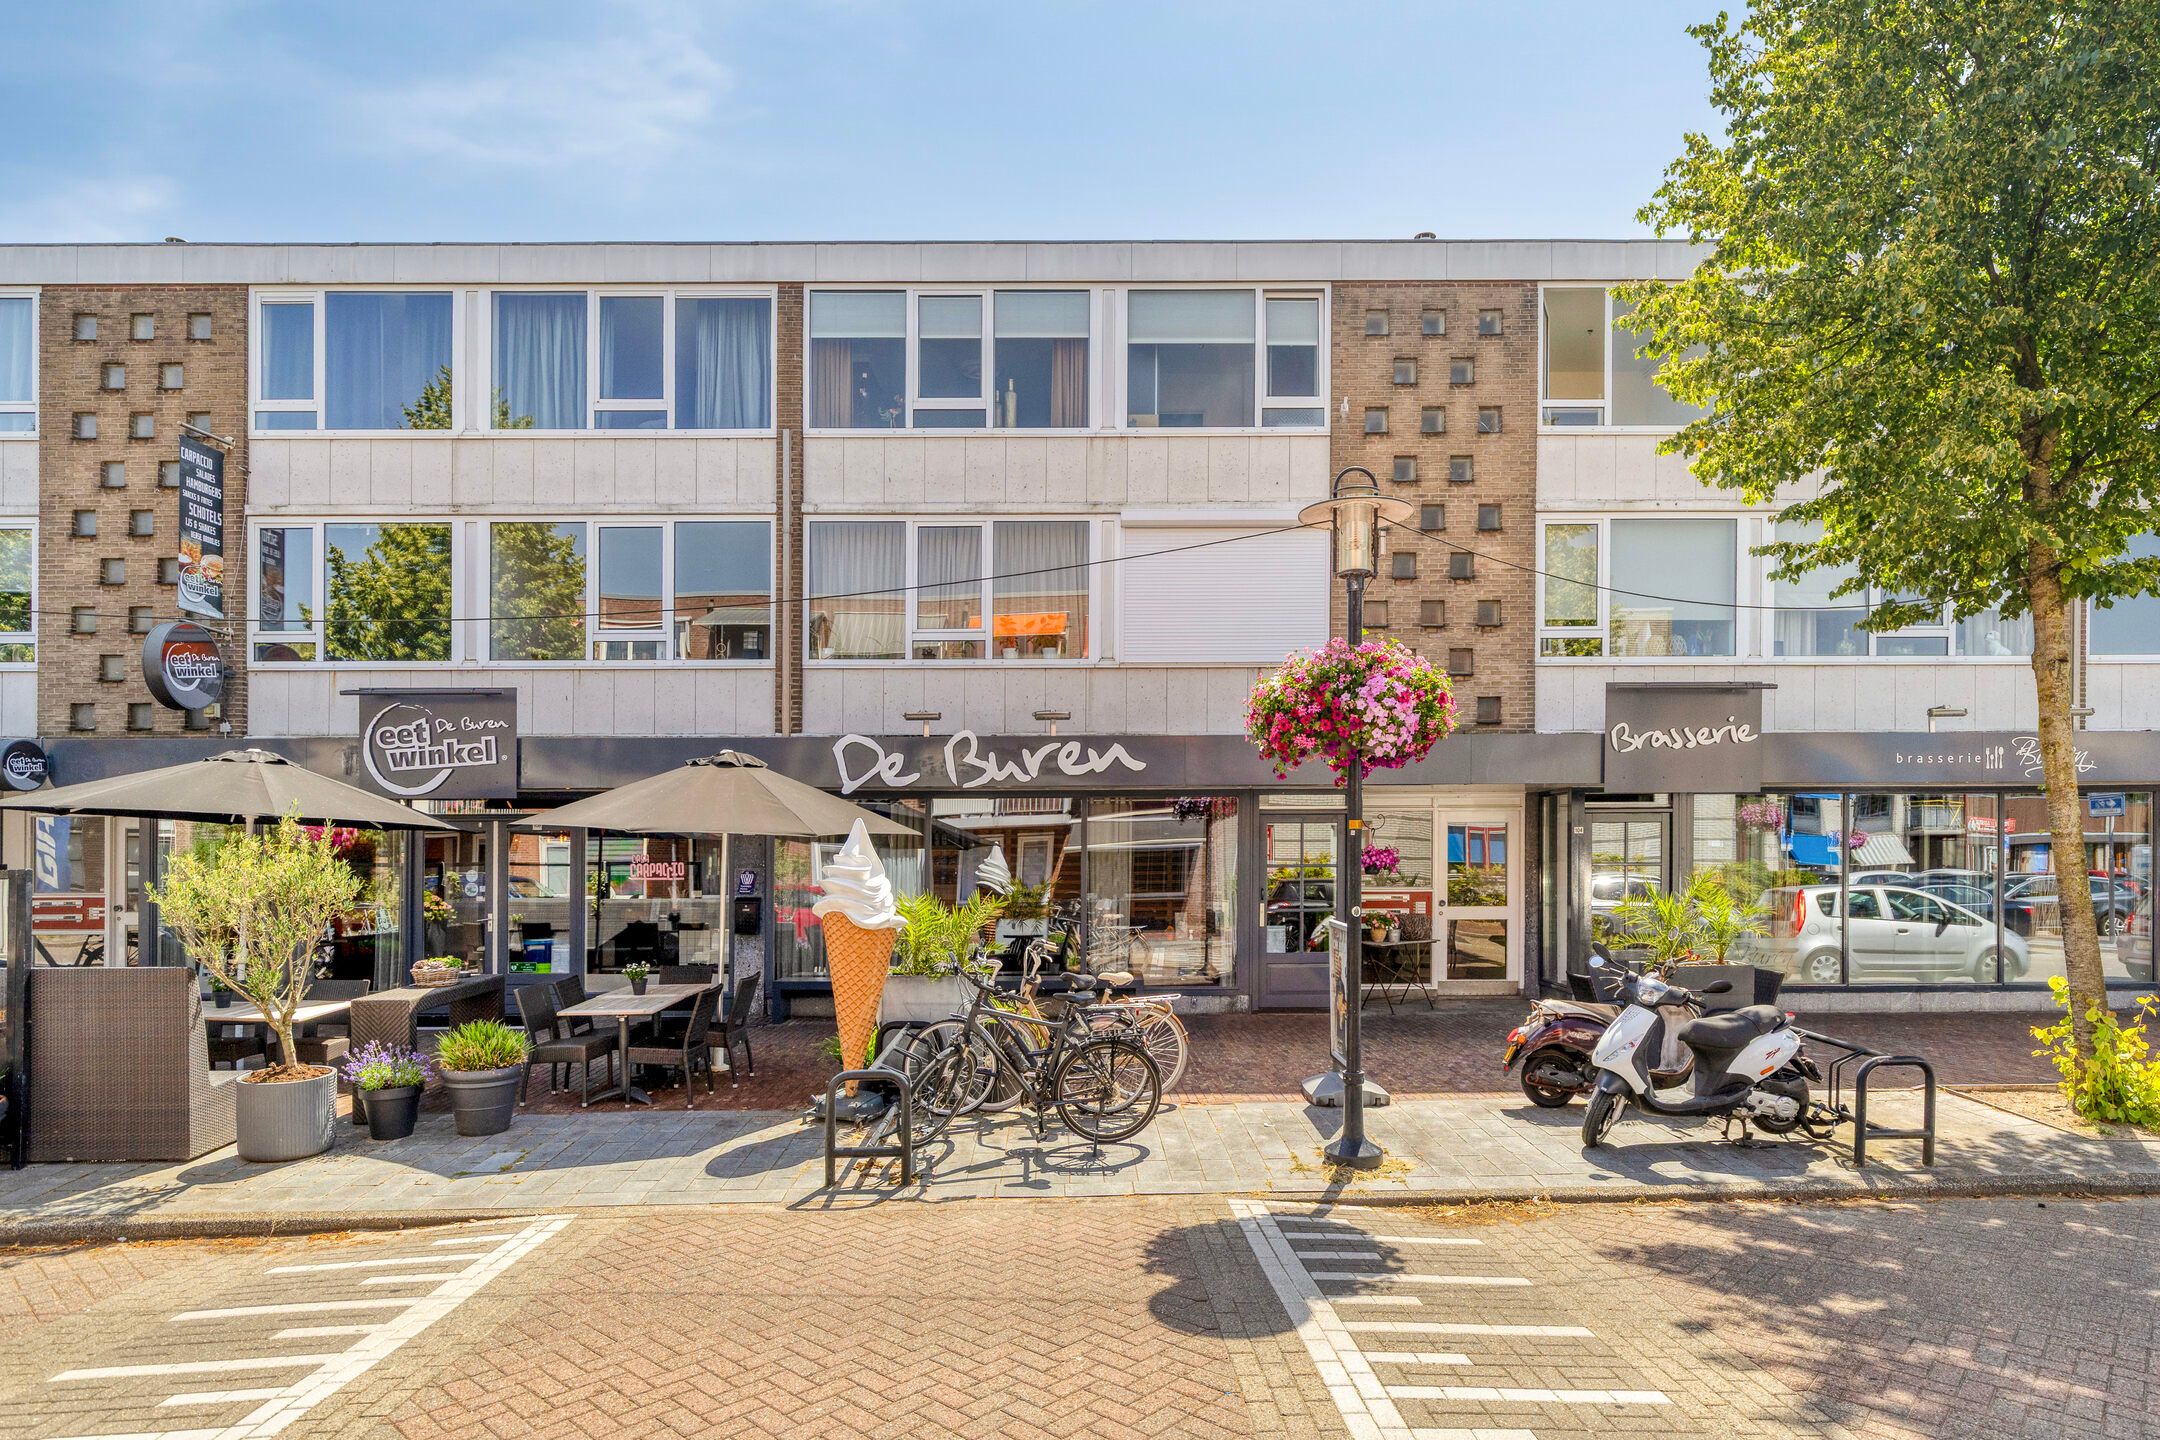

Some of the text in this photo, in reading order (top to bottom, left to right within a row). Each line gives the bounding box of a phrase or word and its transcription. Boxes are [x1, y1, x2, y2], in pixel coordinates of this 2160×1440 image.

[180, 446, 213, 470] CARPACCIO
[195, 468, 216, 484] SALADES
[185, 475, 222, 500] HAMBURGERS
[188, 502, 222, 526] SCHOTELS
[198, 521, 216, 536] SHAKES
[187, 582, 219, 597] winkel
[170, 652, 192, 666] eet
[191, 653, 220, 662] De Buren
[174, 663, 217, 678] winkel
[435, 716, 510, 733] De Buren
[376, 717, 431, 749] eet
[1610, 715, 1759, 753] Brasserie
[385, 735, 497, 771] winkel
[1896, 752, 1982, 764] brasserie
[10, 757, 25, 766] eet
[12, 763, 43, 773] winkel
[833, 729, 1147, 795] De Buren
[631, 854, 650, 864] CASA
[630, 861, 685, 880] CARPACCIO
